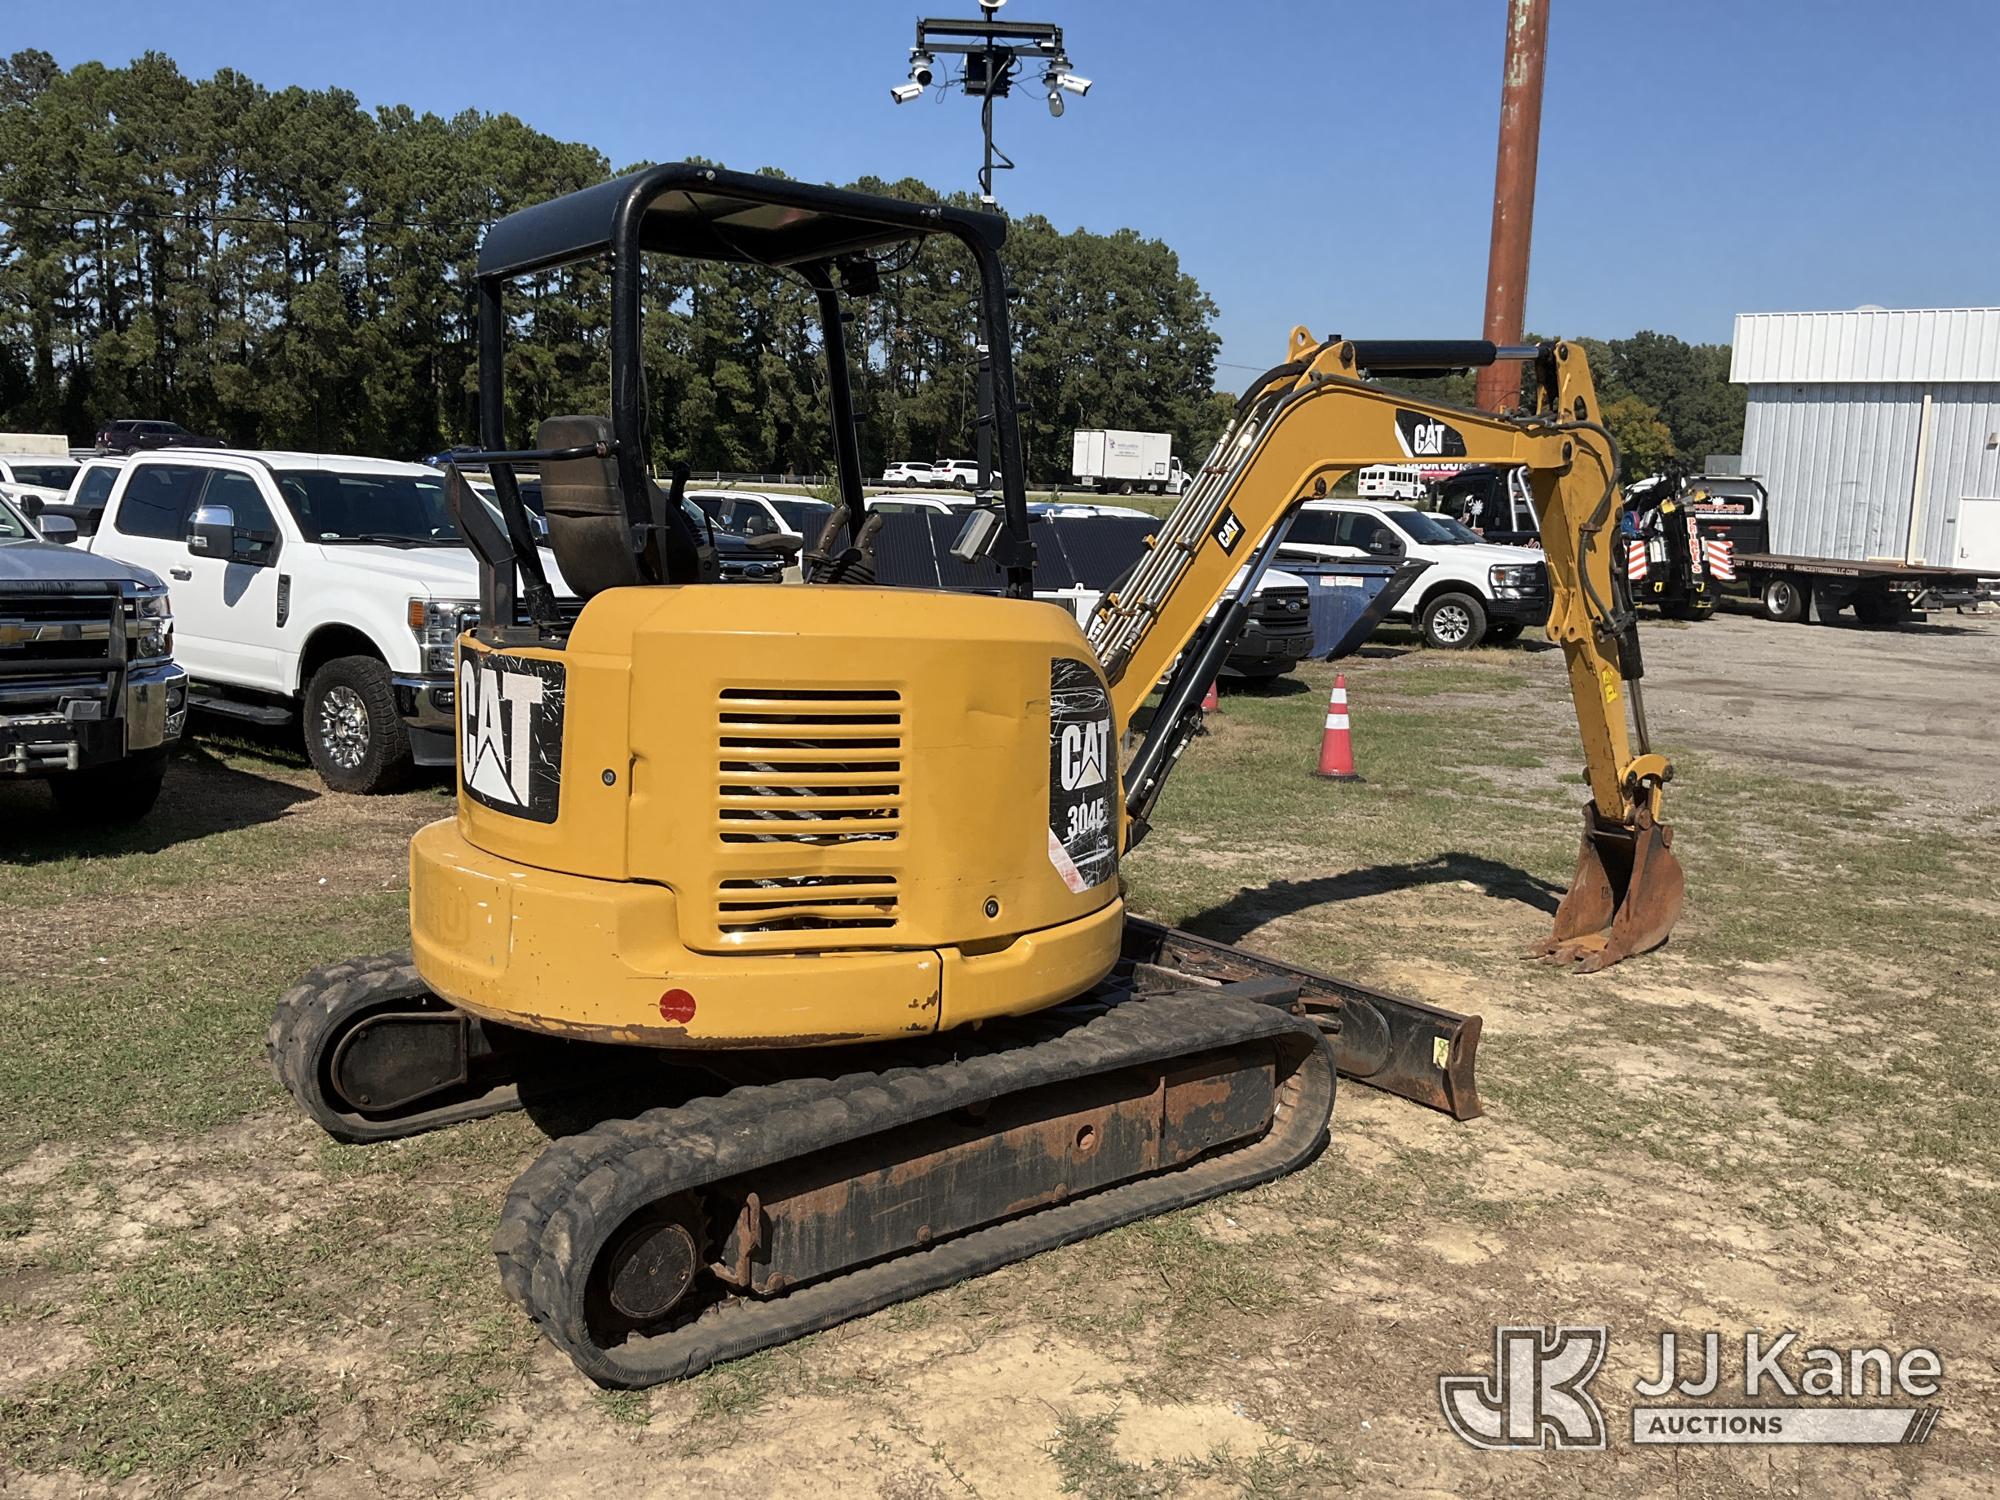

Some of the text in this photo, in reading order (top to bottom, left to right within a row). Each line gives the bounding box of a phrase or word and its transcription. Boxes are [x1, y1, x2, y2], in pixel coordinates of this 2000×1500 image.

[1414, 423, 1445, 455] CAT
[1217, 513, 1240, 548] CAT
[460, 659, 543, 808] CAT
[1061, 718, 1110, 792] CAT
